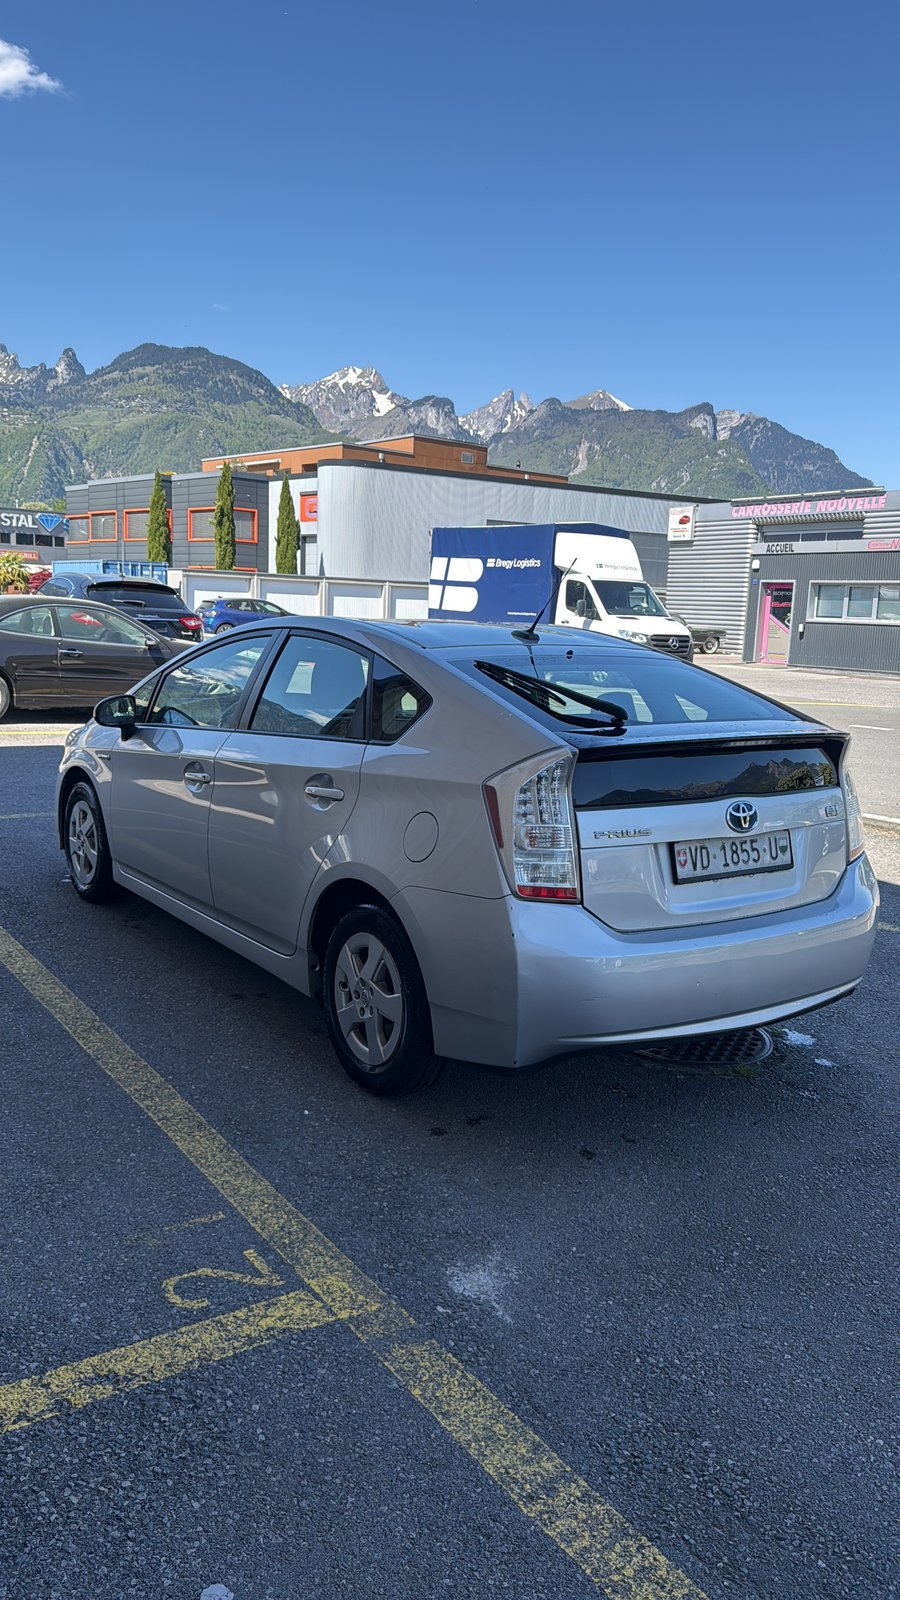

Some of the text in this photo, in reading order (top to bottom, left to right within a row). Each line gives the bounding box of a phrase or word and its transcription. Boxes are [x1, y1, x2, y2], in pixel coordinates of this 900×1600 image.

[731, 495, 886, 517] CARROSSERIE NOUVELLE
[766, 543, 795, 553] ACCUEIL
[495, 558, 541, 569] Bregy Logistics
[593, 828, 653, 840] PRIUS
[688, 844, 711, 872] VD
[719, 838, 761, 868] 1855
